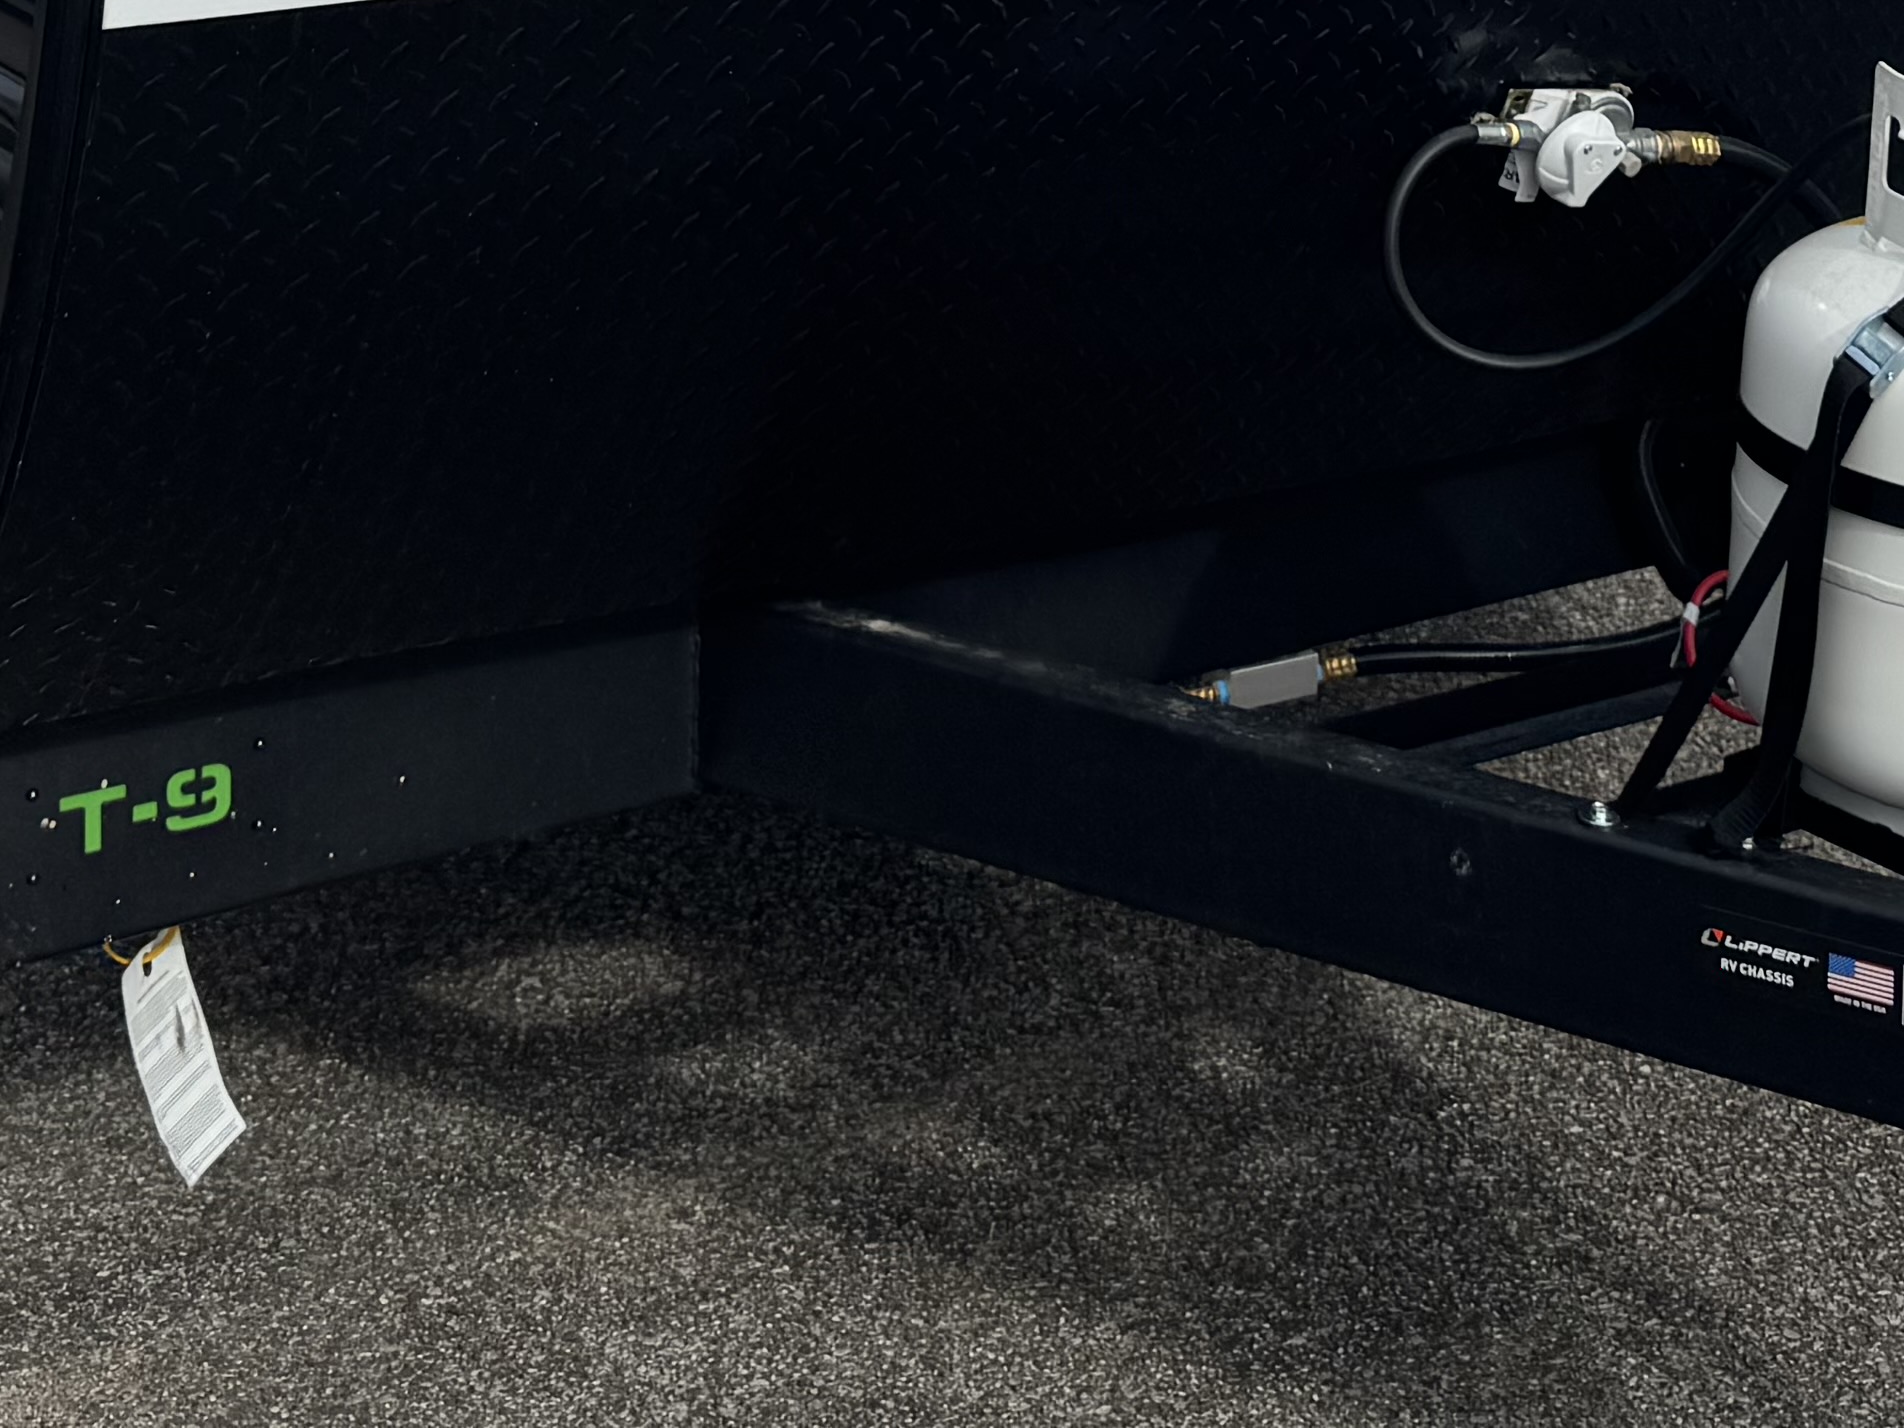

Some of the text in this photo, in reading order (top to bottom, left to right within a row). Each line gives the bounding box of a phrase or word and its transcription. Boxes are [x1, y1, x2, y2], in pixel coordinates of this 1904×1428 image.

[59, 763, 232, 854] T-9
[1721, 957, 1794, 988] RV CHASSIS
